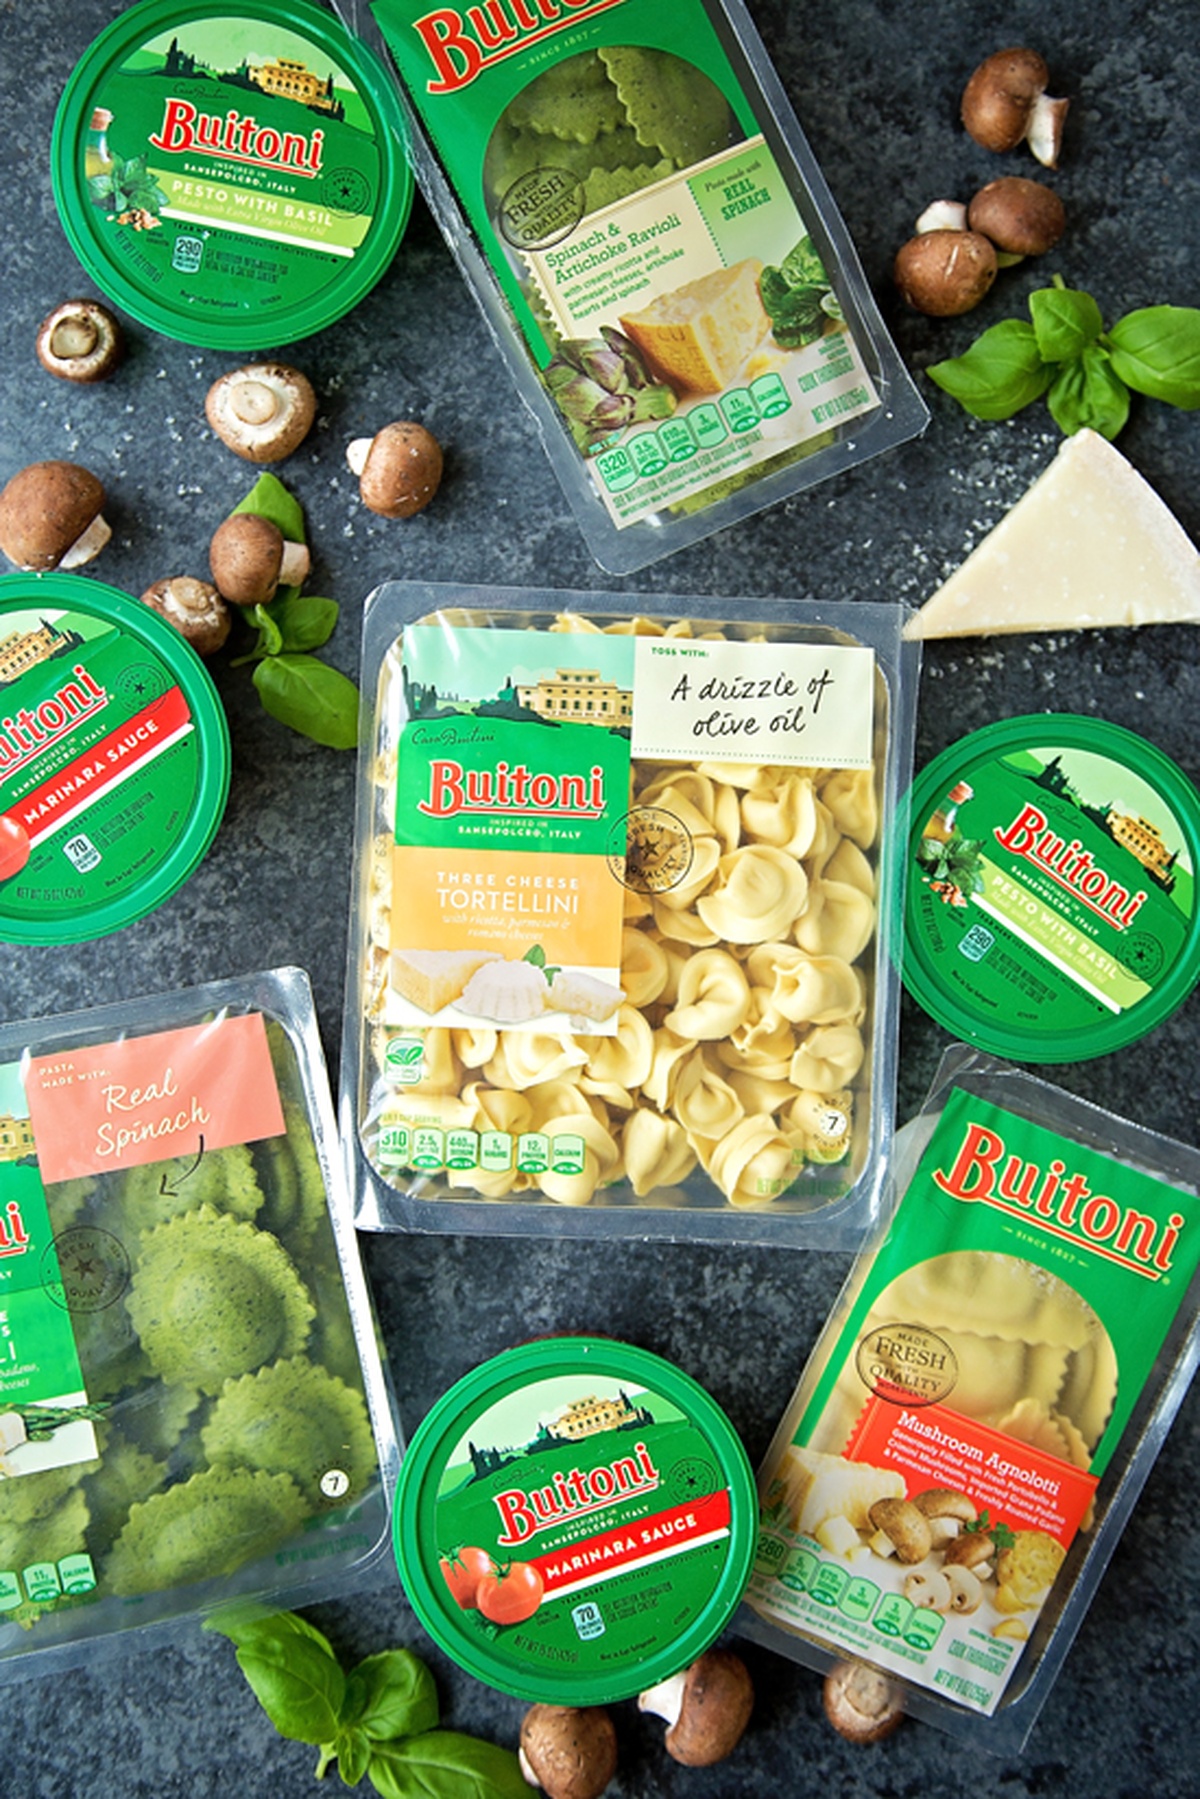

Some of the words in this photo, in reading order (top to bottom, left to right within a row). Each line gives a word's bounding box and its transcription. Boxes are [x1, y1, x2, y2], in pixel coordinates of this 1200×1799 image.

[149, 97, 324, 178] Buitoni
[172, 180, 228, 202] PESTO
[234, 193, 277, 213] WITH
[284, 205, 334, 226] BASIL
[267, 182, 295, 193] ITALY
[505, 174, 565, 224] FRESH
[723, 178, 755, 201] REAL
[520, 194, 577, 242] QUALITY
[721, 187, 771, 221] SPINACH
[545, 231, 609, 268] Spinach
[608, 223, 621, 237] &
[555, 242, 627, 285] Artichoke
[627, 213, 681, 247] Ravioli
[563, 285, 582, 299] with
[583, 270, 613, 289] creamy
[614, 255, 643, 273] ricotta
[644, 246, 660, 259] and
[568, 285, 609, 311] parmesan
[609, 269, 645, 289] cheeses,
[646, 248, 684, 272] artichoke
[572, 303, 601, 320] hearts
[601, 293, 618, 307] and
[618, 278, 651, 298] spinach
[600, 451, 628, 474] 320
[652, 647, 677, 656] TOSS
[680, 649, 706, 657] WITH:
[671, 674, 691, 701] A
[698, 672, 798, 700] drizzle
[807, 669, 834, 714] of
[81, 724, 106, 745] ITALY
[693, 710, 760, 737] olive
[769, 706, 806, 733] oil
[24, 761, 106, 824] MARINARA
[107, 720, 158, 762] SAUCE
[420, 759, 607, 819] Buitoni
[459, 826, 543, 837] SANSEPOLCRO,
[549, 830, 580, 838] ITALY
[626, 824, 663, 841] FRESH
[68, 839, 88, 857] 70
[437, 871, 495, 885] THREE
[506, 875, 578, 889] CHEESE
[629, 855, 675, 877] QUALITY
[993, 802, 1149, 930] Buitoni
[436, 888, 578, 913] TORTELLINI
[443, 914, 467, 923] with
[469, 914, 504, 927] ricotta,
[508, 917, 559, 929] parmesan
[468, 930, 506, 938] romano
[508, 929, 543, 940] cheeses
[992, 875, 1038, 914] PESTO
[1041, 912, 1077, 945] WITH
[1078, 943, 1122, 979] BASIL
[1075, 915, 1099, 935] ITALY
[968, 927, 992, 949] 290
[39, 1064, 74, 1076] PASTA
[42, 1076, 72, 1088] MADE
[78, 1070, 110, 1082] WITH:
[101, 1068, 178, 1113] Real
[95, 1106, 210, 1158] Spinach
[828, 1115, 838, 1129] 7
[382, 1131, 406, 1146] 310
[931, 1122, 1185, 1281] Buitoni
[874, 1335, 946, 1370] FRESH
[897, 1332, 928, 1347] MADE
[870, 1363, 940, 1392] QUALITY
[897, 1410, 983, 1462] Mushroom
[985, 1452, 1060, 1496] Agnolotti
[328, 1475, 340, 1491] 7
[887, 1438, 918, 1457] Crimini
[919, 1452, 967, 1482] Mushrooms,
[970, 1476, 1009, 1499] Imported
[1009, 1494, 1034, 1510] Grana
[1035, 1505, 1065, 1524] Padano
[892, 1428, 938, 1456] Generously
[939, 1450, 963, 1466] Filled
[964, 1463, 982, 1475] with
[984, 1470, 1006, 1485] Fresh
[1007, 1481, 1050, 1506] Portobello
[1049, 1500, 1058, 1510] &
[492, 1442, 659, 1546] Buitoni
[882, 1447, 892, 1457] &
[892, 1451, 932, 1475] Parmesan
[933, 1470, 965, 1491] Cheeses
[965, 1485, 975, 1495] &
[975, 1489, 1004, 1510] Freshly
[1005, 1503, 1038, 1524] Roasted
[1038, 1519, 1061, 1534] Garlic
[621, 1505, 648, 1520] ITALY
[546, 1538, 636, 1579] MARINARA
[641, 1514, 696, 1543] SAUCE
[755, 1537, 784, 1561] 280
[577, 1606, 595, 1623] 70
